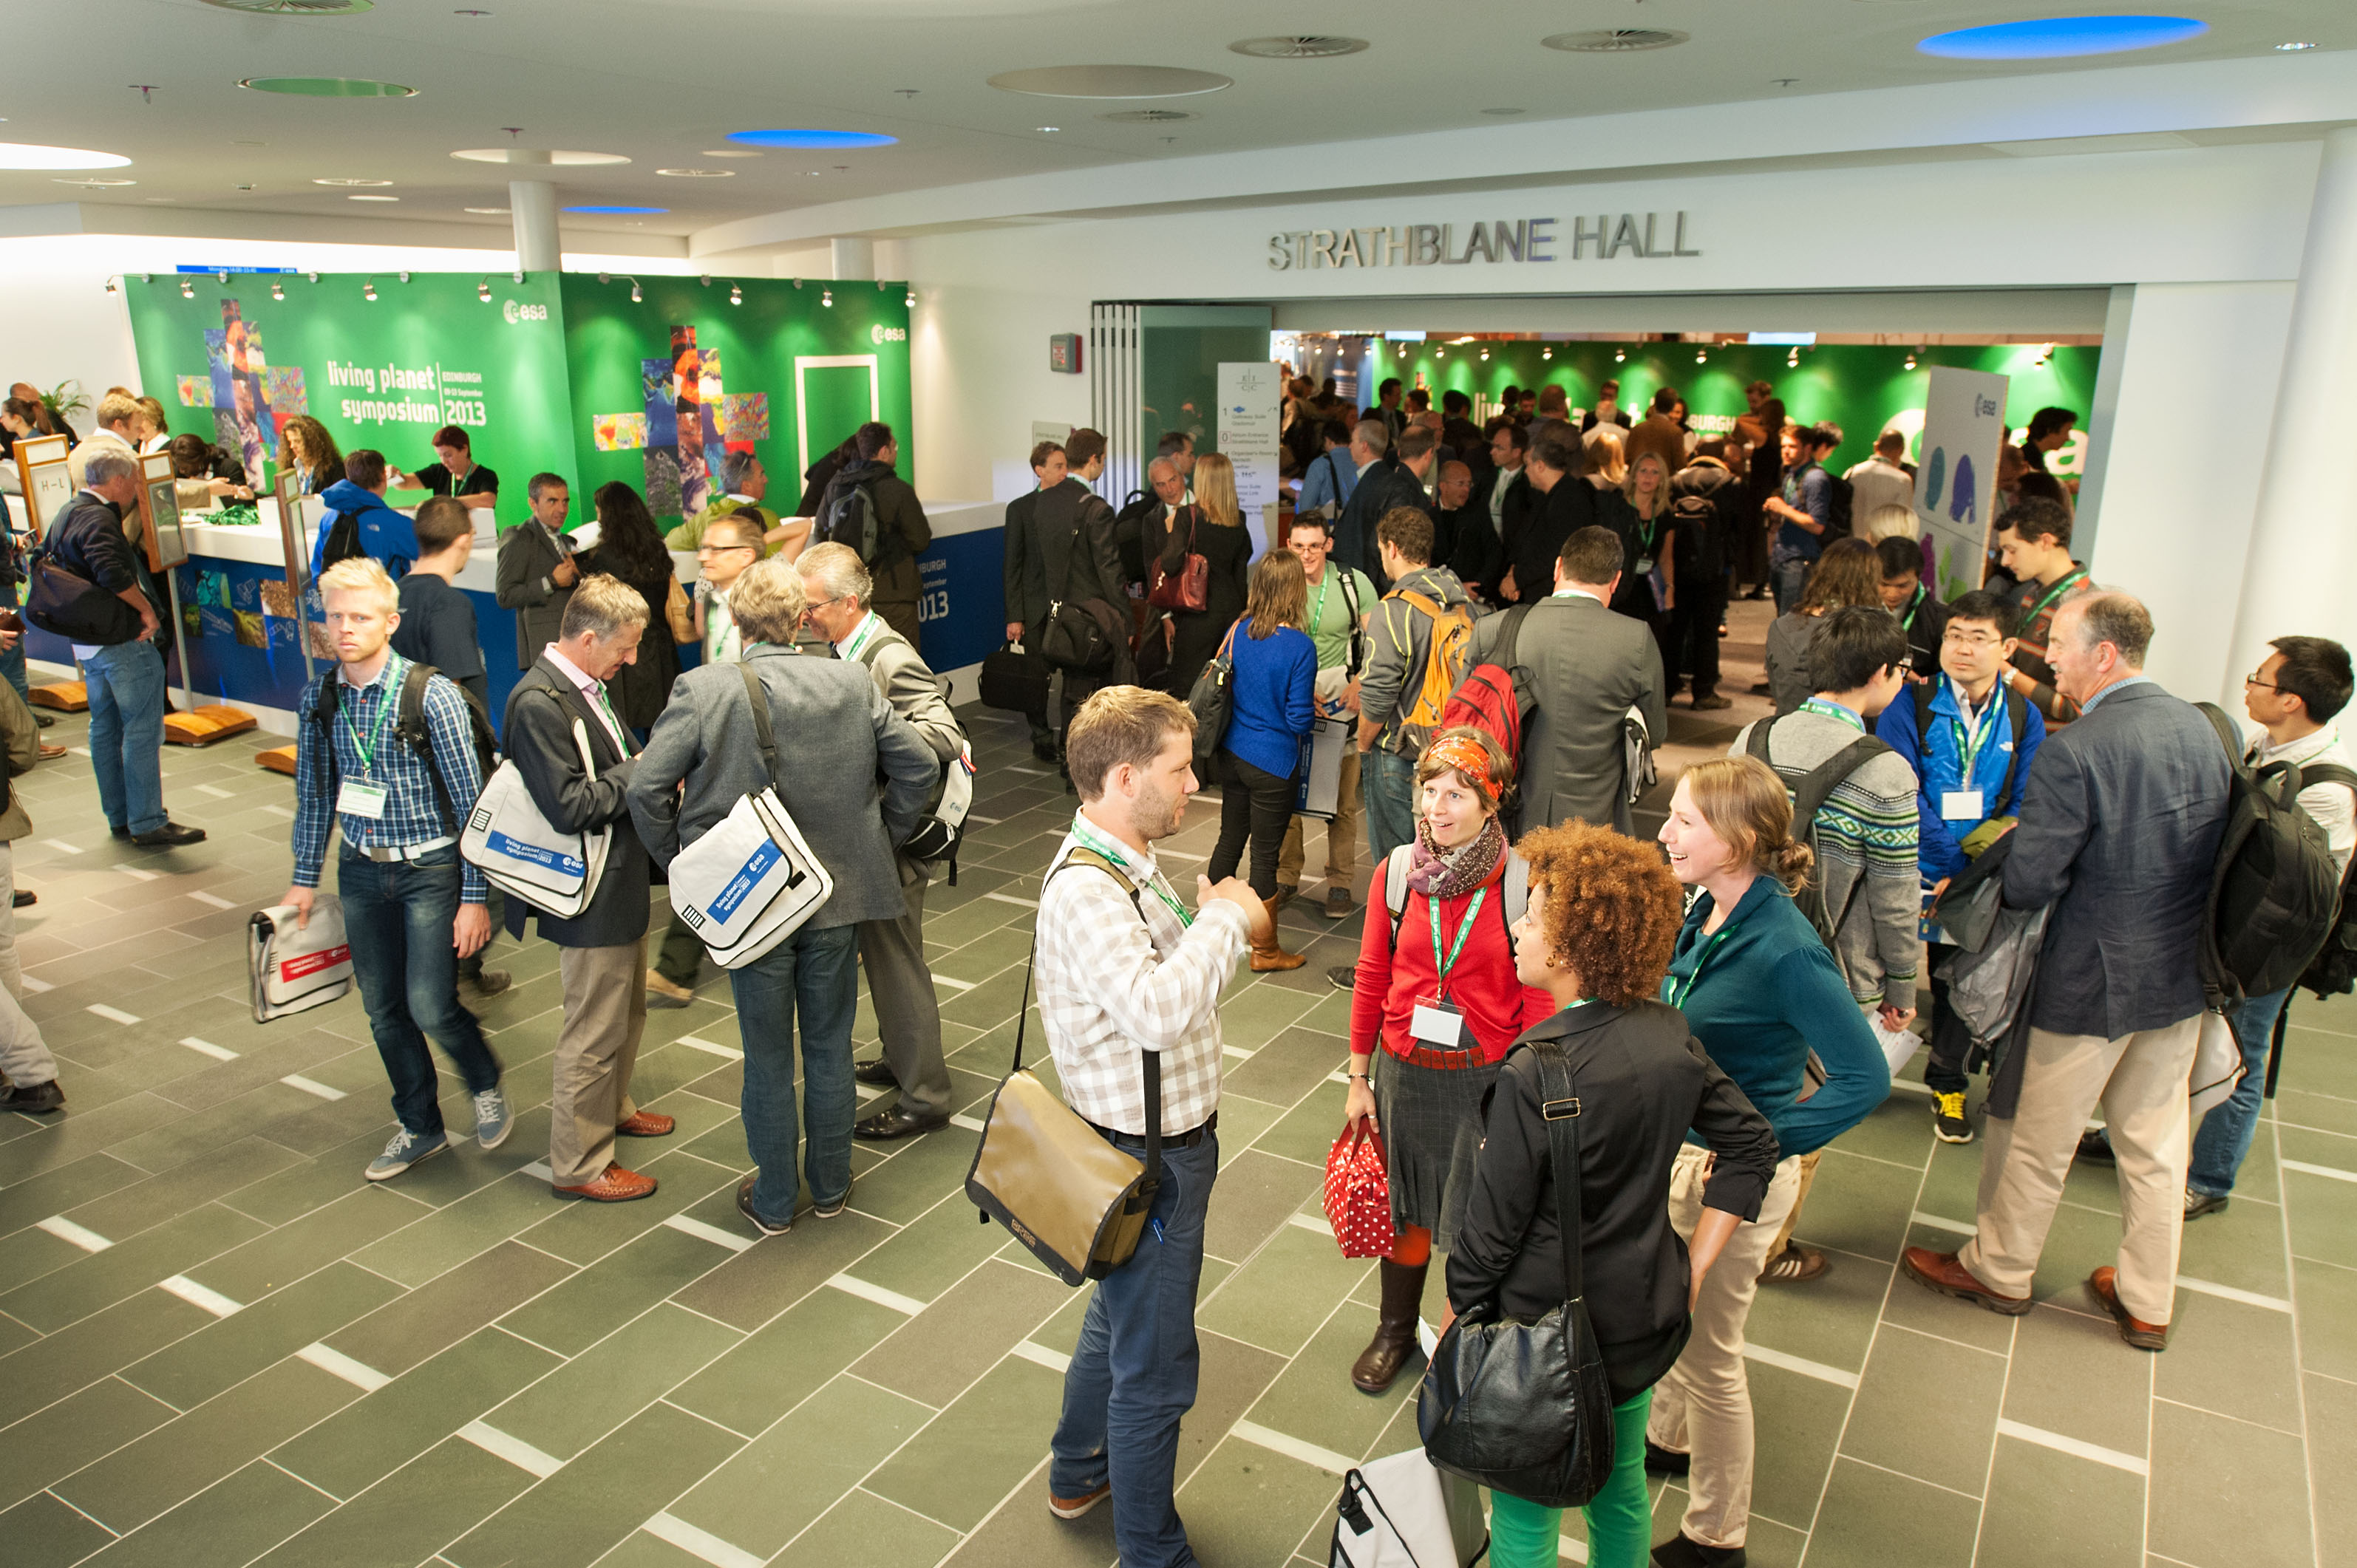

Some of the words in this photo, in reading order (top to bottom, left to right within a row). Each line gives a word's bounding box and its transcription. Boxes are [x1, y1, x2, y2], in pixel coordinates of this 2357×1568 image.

[1266, 217, 1559, 270] STRATHBLANE
[1573, 211, 1703, 260] HALL
[327, 360, 375, 394] living
[379, 362, 436, 394] planet
[442, 371, 483, 384] EDINBURGH
[341, 396, 440, 426] symposium
[445, 400, 486, 426] 2013
[1474, 392, 1506, 428] liv
[1685, 414, 1736, 432] BURGH
[1222, 432, 1228, 442] 0
[917, 559, 947, 573] BURGH
[917, 590, 949, 622] 013
[506, 838, 521, 850] living
[521, 845, 540, 853] planet
[506, 846, 538, 859] symposium
[539, 855, 552, 864] 2013
[726, 883, 738, 899] planet
